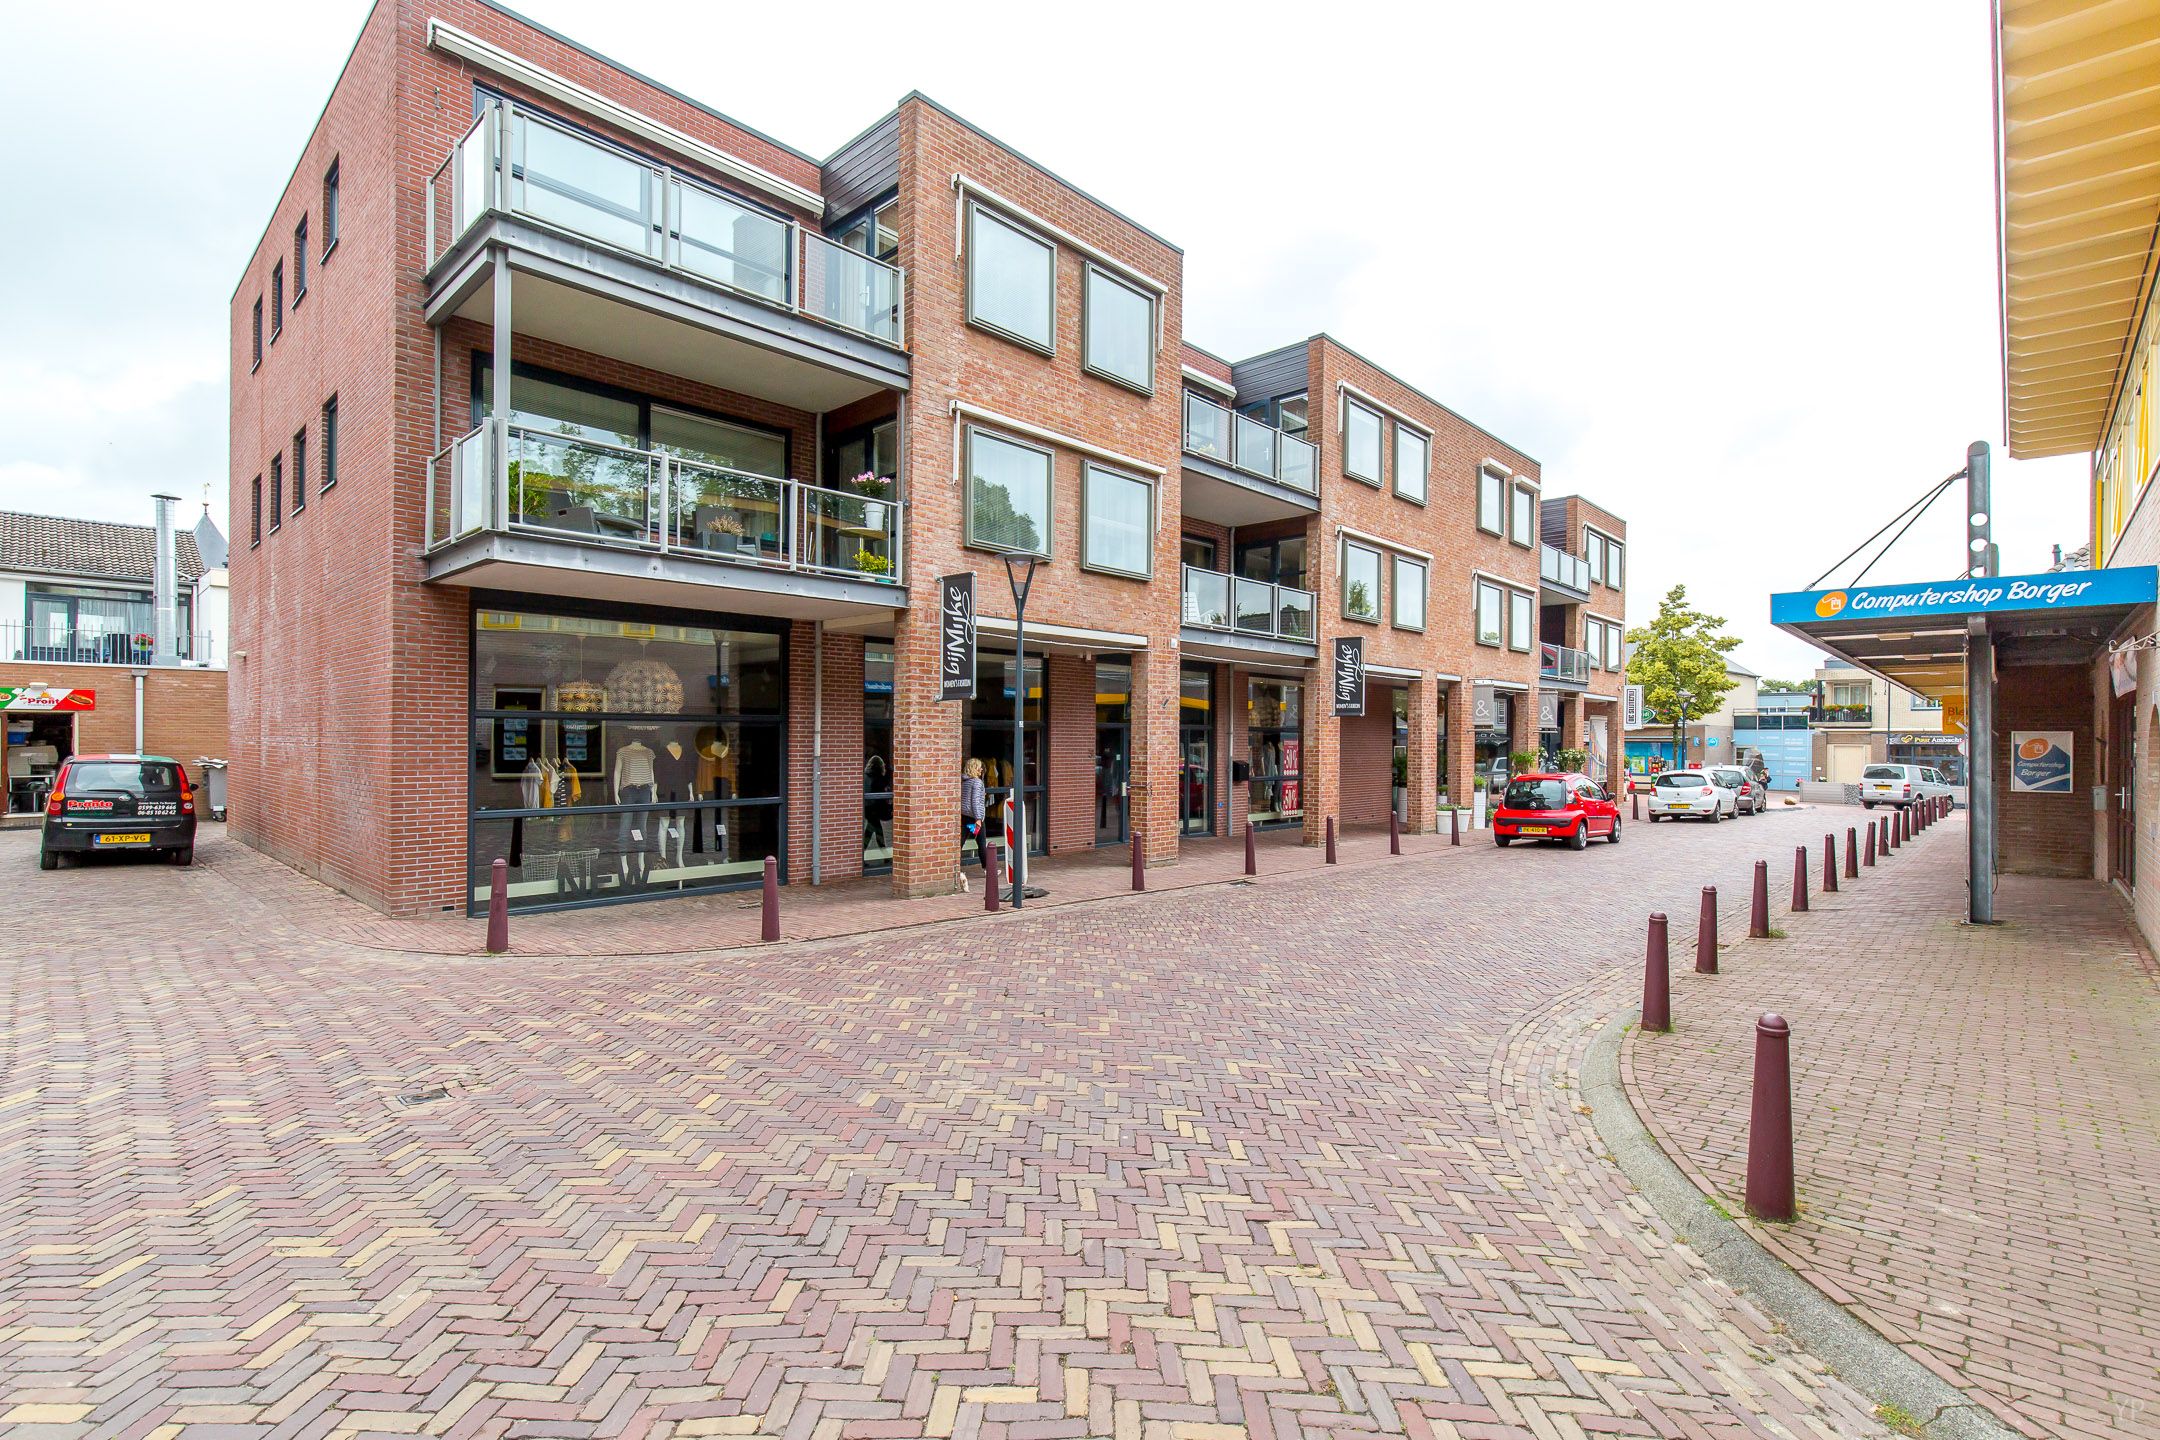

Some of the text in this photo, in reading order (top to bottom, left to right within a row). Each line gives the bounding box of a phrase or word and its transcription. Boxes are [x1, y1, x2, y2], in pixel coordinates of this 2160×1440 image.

[1851, 580, 2093, 612] Computershop Borger
[1475, 700, 1490, 717] &
[1540, 705, 1554, 720] &
[2016, 760, 2066, 769] Computershop
[2020, 768, 2052, 779] Borger
[67, 800, 113, 808] Pronto
